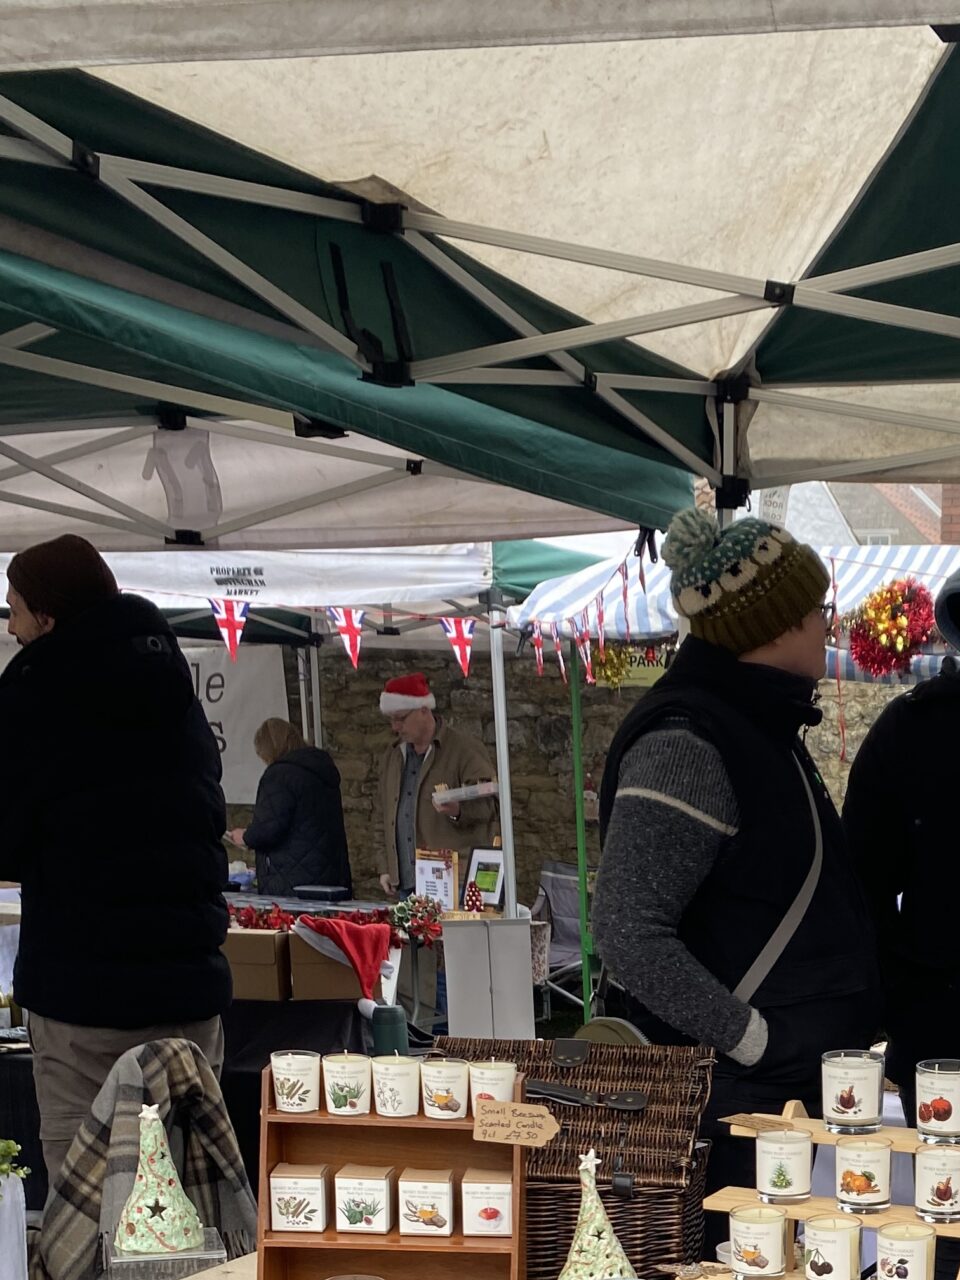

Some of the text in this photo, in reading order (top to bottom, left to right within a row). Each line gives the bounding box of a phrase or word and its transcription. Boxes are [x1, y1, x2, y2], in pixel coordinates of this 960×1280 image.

[210, 567, 252, 576] PROPERTY
[226, 588, 260, 596] MARKET
[481, 1105, 506, 1115] Small
[479, 1119, 511, 1128] Scented
